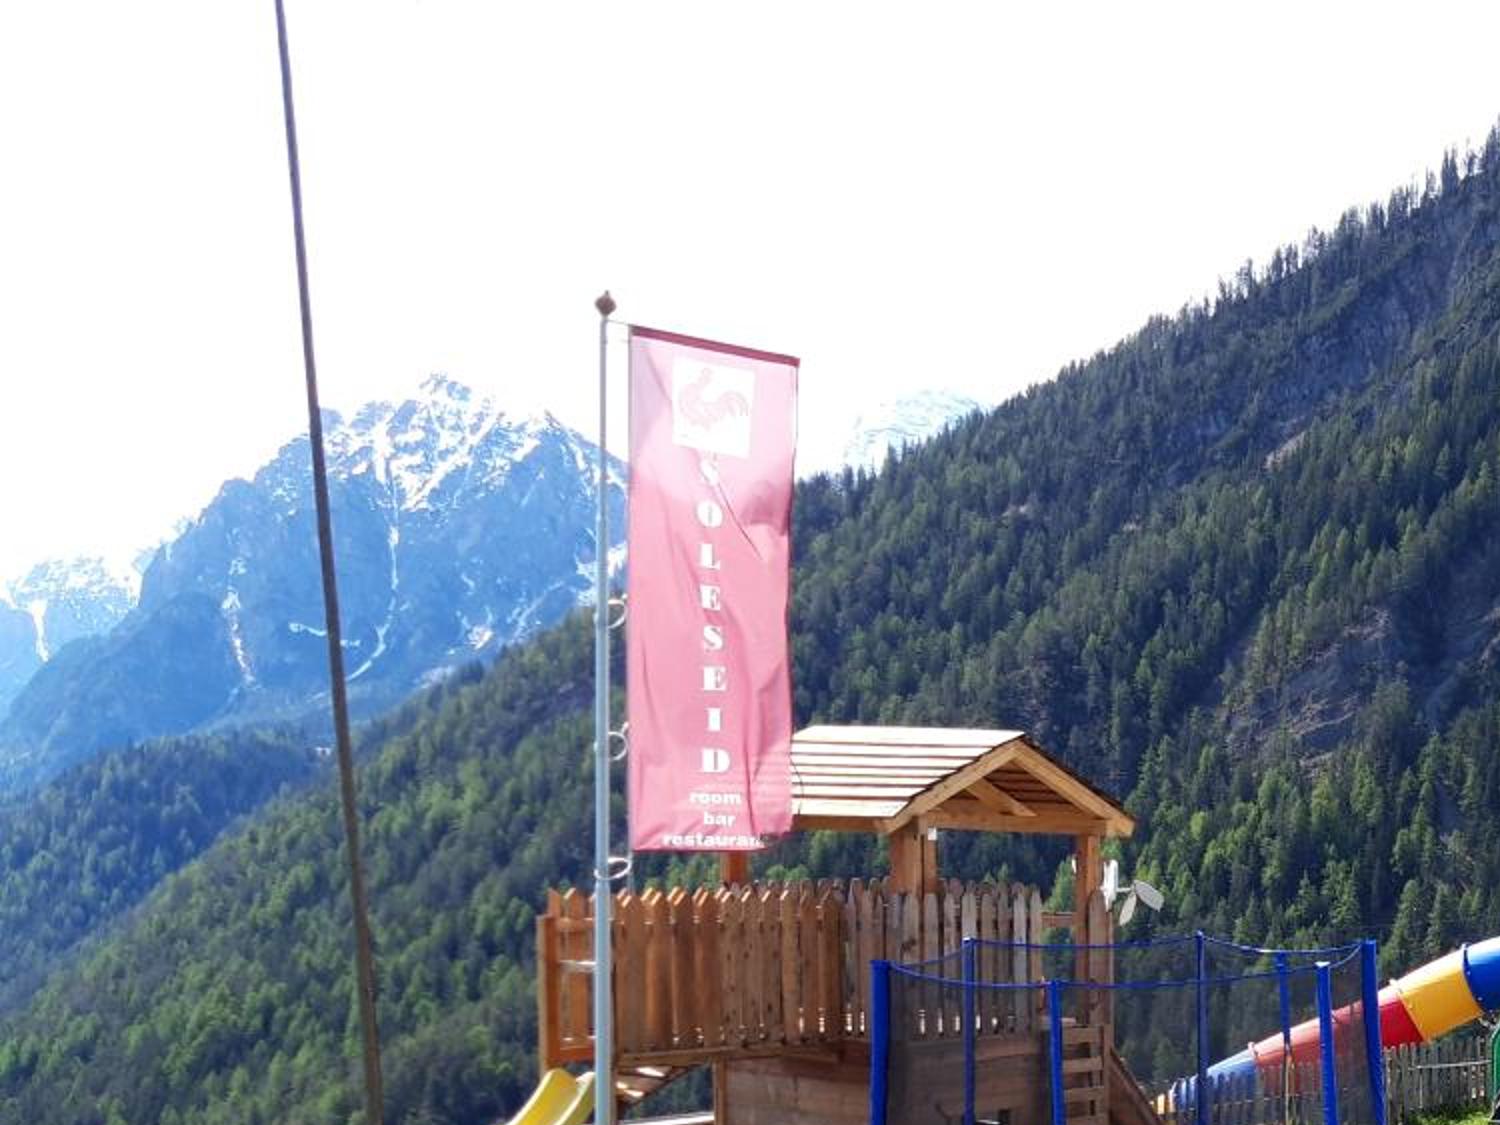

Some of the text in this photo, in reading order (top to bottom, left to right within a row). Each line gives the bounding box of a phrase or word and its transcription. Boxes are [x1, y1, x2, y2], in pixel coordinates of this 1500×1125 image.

[697, 454, 732, 773] SOLESEID
[689, 791, 742, 804] room
[703, 810, 735, 826] bar
